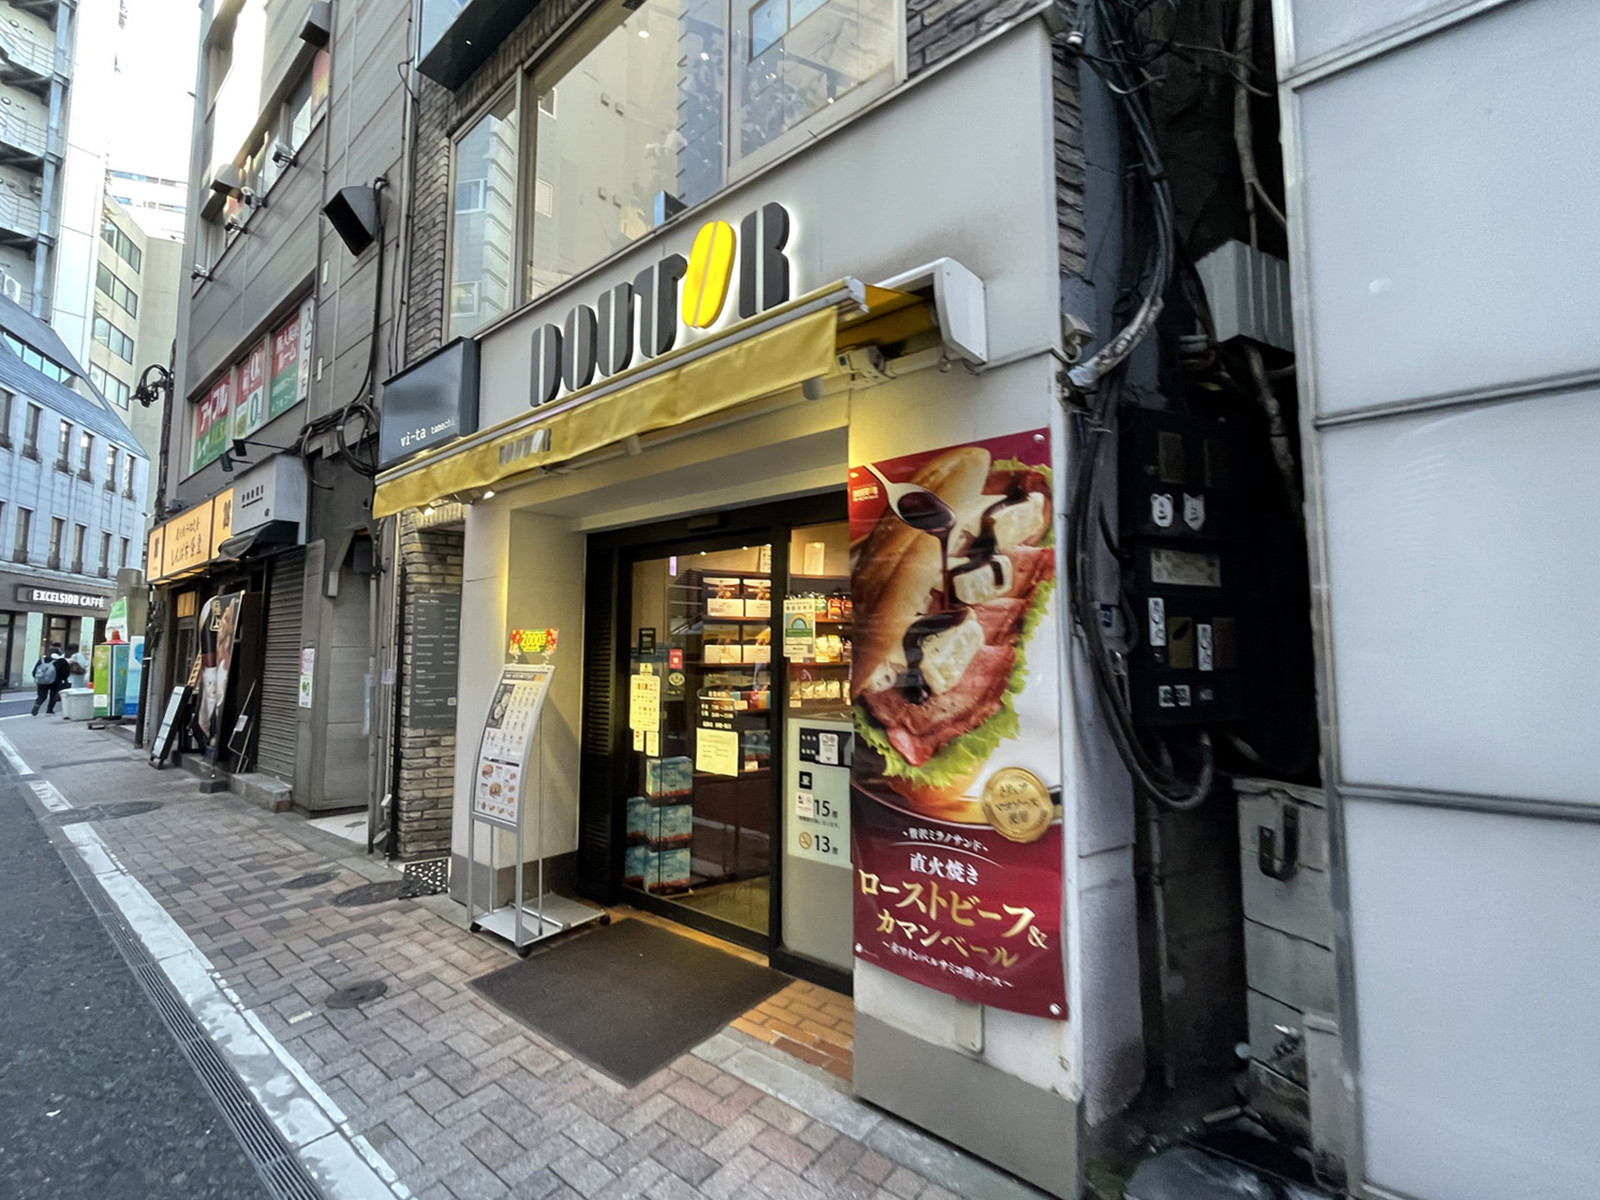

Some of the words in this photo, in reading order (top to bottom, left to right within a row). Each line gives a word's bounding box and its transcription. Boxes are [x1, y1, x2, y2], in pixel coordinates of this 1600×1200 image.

[530, 202, 790, 408] DOUTOR
[400, 427, 427, 448] vi-ta
[32, 589, 79, 605] EXCELSIOR
[909, 852, 980, 886] 直火焼き
[876, 908, 1019, 969] カマンベール
